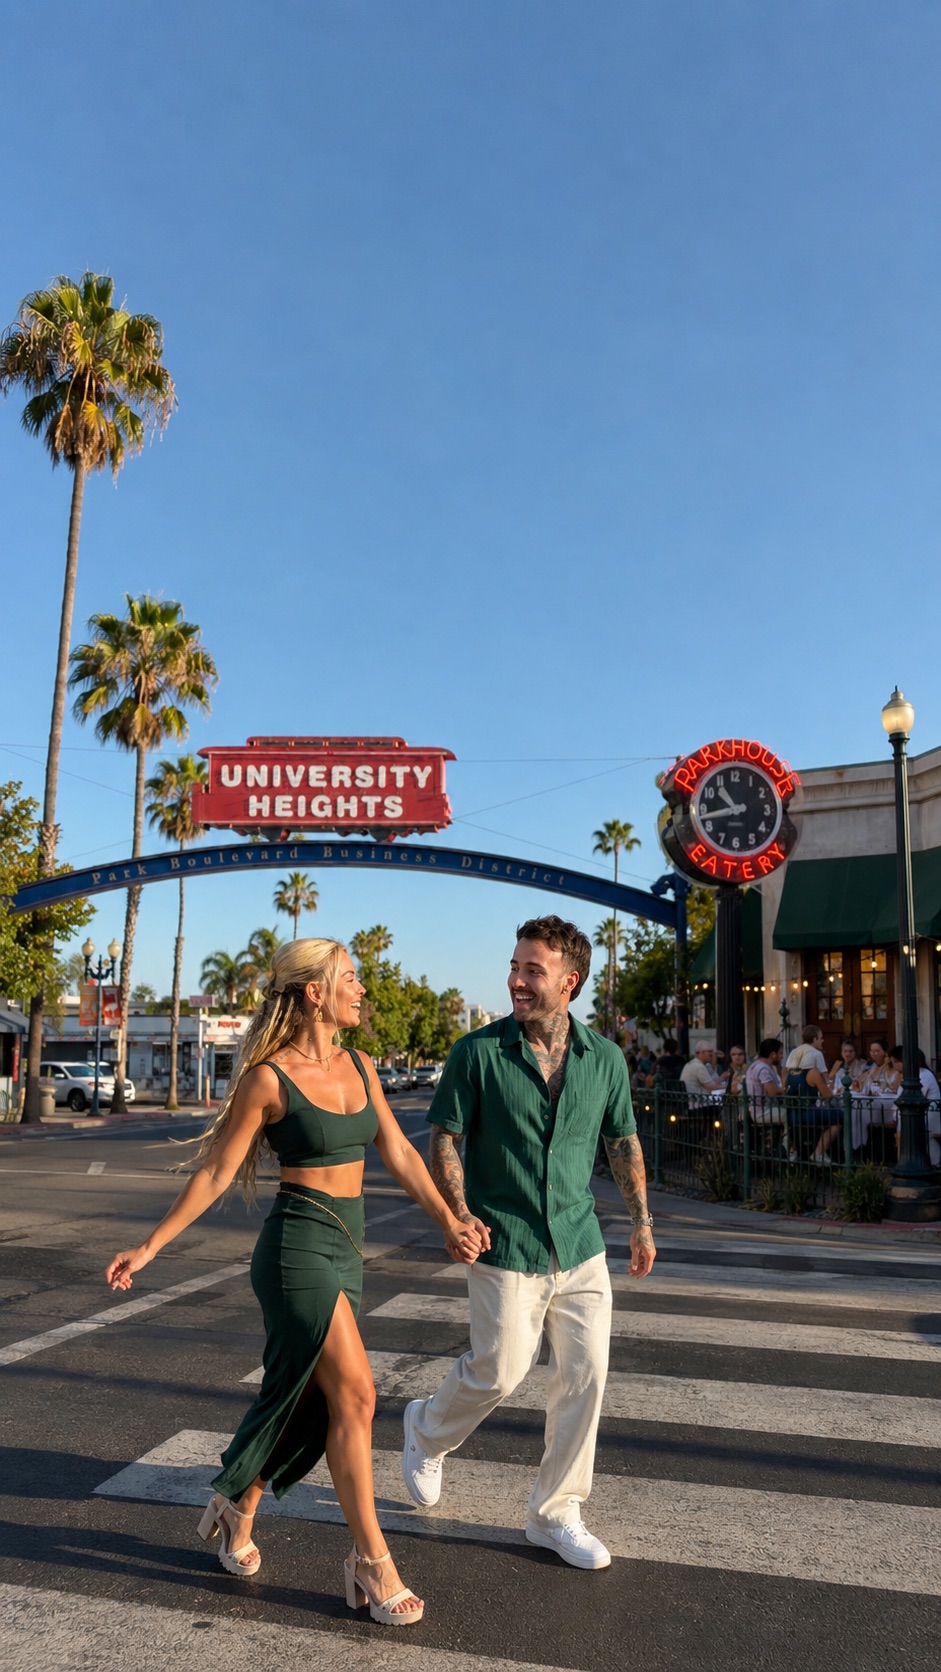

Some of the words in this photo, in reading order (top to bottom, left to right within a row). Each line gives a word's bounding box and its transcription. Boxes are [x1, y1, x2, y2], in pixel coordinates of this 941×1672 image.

[674, 739, 793, 798] PARKHOUSE
[221, 764, 432, 789] UNIVERSITY
[716, 775, 724, 786] 11
[730, 770, 740, 783] 12
[749, 776, 753, 787] 1
[704, 787, 715, 799] 10
[758, 787, 765, 799] 2
[249, 795, 403, 818] HEIGHTS
[700, 803, 707, 814] 9
[764, 804, 771, 816] 3
[705, 820, 713, 832] 8
[758, 821, 766, 833] 4
[718, 833, 726, 845] 7
[732, 837, 740, 848] 6
[748, 833, 756, 845] 5
[91, 864, 147, 885] Park
[171, 847, 299, 869] Boulevard
[323, 846, 438, 864] Business
[461, 856, 566, 885] District
[690, 843, 785, 879] EATERY
